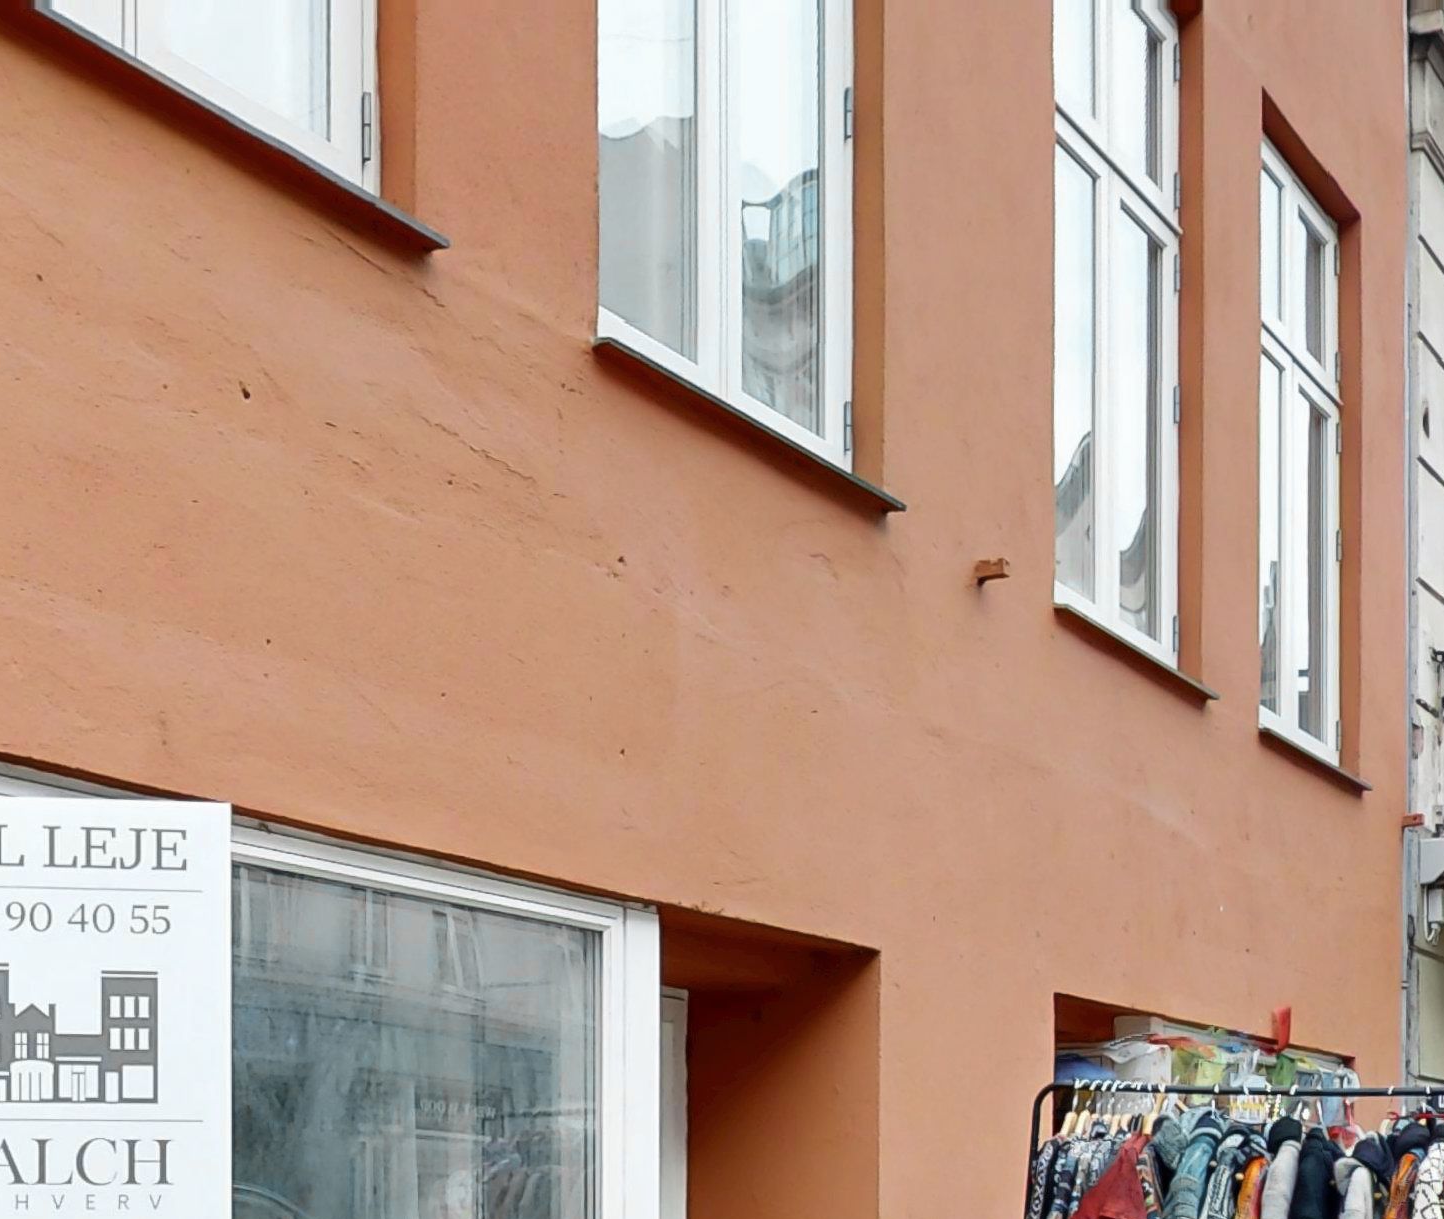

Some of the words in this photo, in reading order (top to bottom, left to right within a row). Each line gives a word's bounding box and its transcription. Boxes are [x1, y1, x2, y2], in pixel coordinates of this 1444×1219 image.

[42, 826, 187, 872] LEJE
[6, 902, 52, 933] 90
[68, 904, 114, 934] 40
[130, 905, 171, 935] 55
